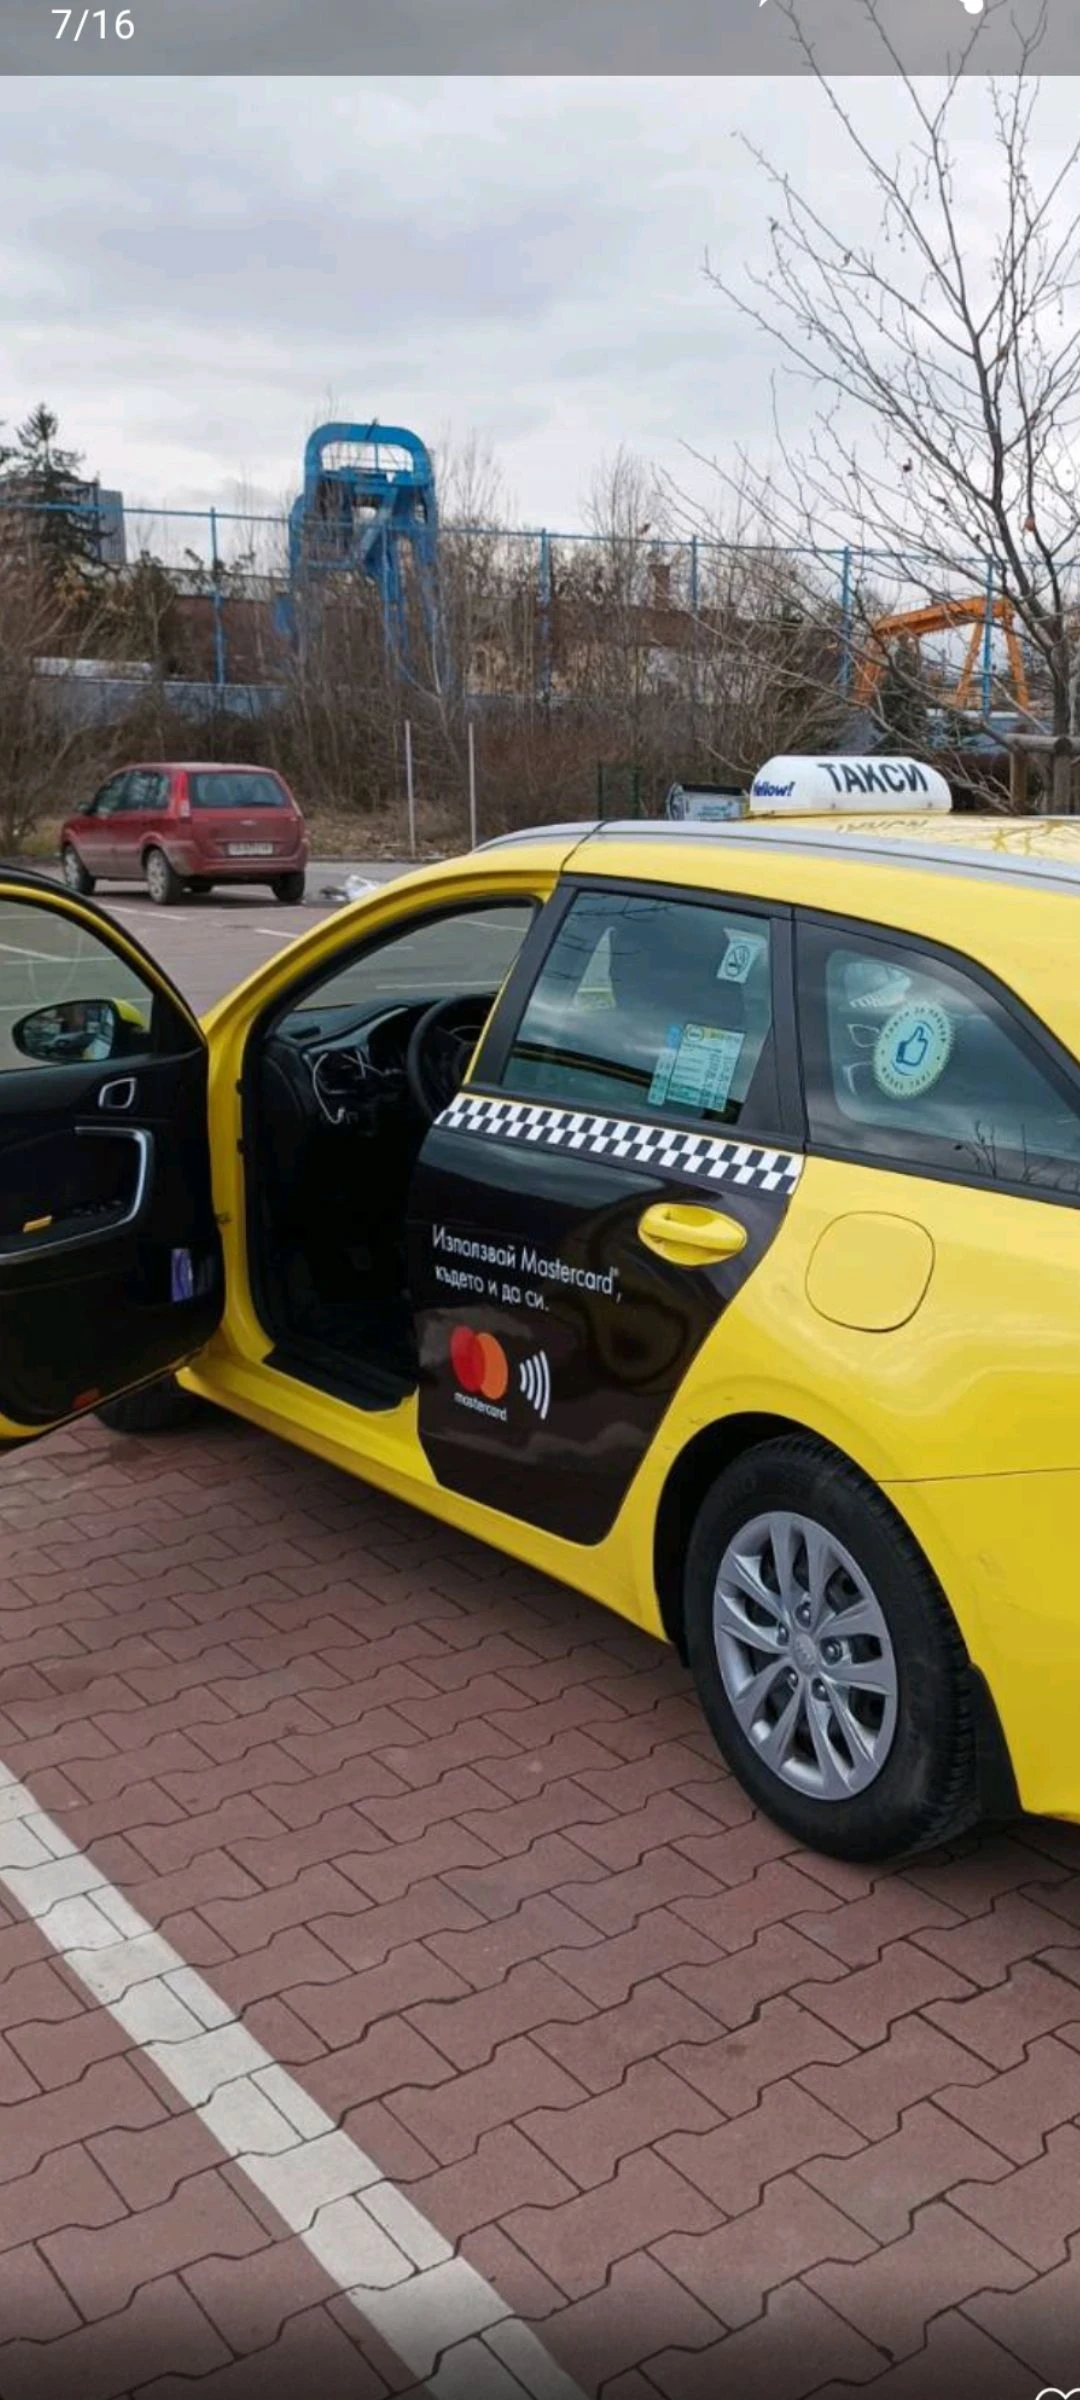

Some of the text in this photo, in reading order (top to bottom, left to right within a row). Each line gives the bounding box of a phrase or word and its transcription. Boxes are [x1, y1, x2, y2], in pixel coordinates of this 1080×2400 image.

[817, 762, 928, 793] ТАКСИ
[432, 1223, 516, 1269] Използвай
[434, 1264, 550, 1312] където и да си.
[454, 1392, 507, 1422] mastercard
